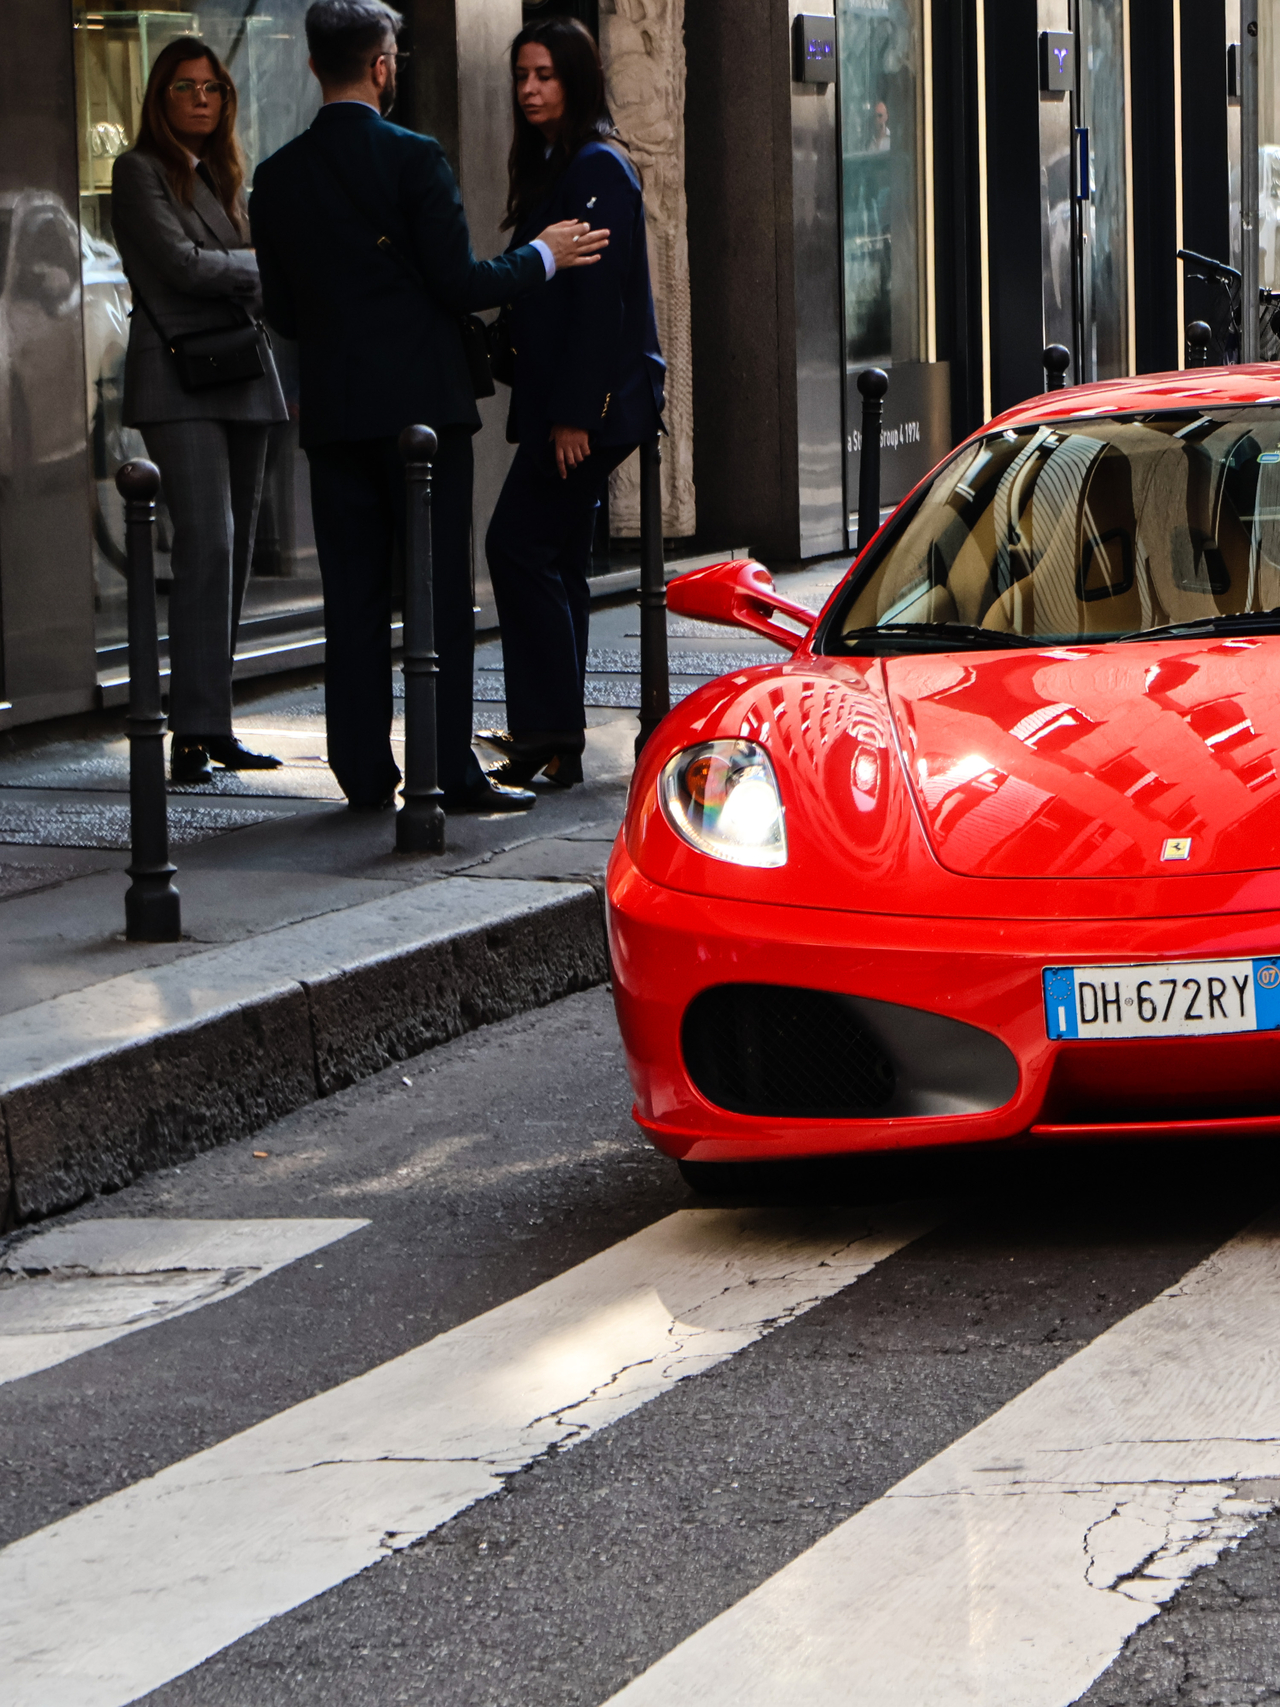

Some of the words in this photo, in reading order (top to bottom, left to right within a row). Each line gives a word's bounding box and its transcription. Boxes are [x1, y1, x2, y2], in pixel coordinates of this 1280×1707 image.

[1262, 970, 1276, 983] 07
[1078, 981, 1122, 1024] DH
[1136, 974, 1249, 1023] 672RY
